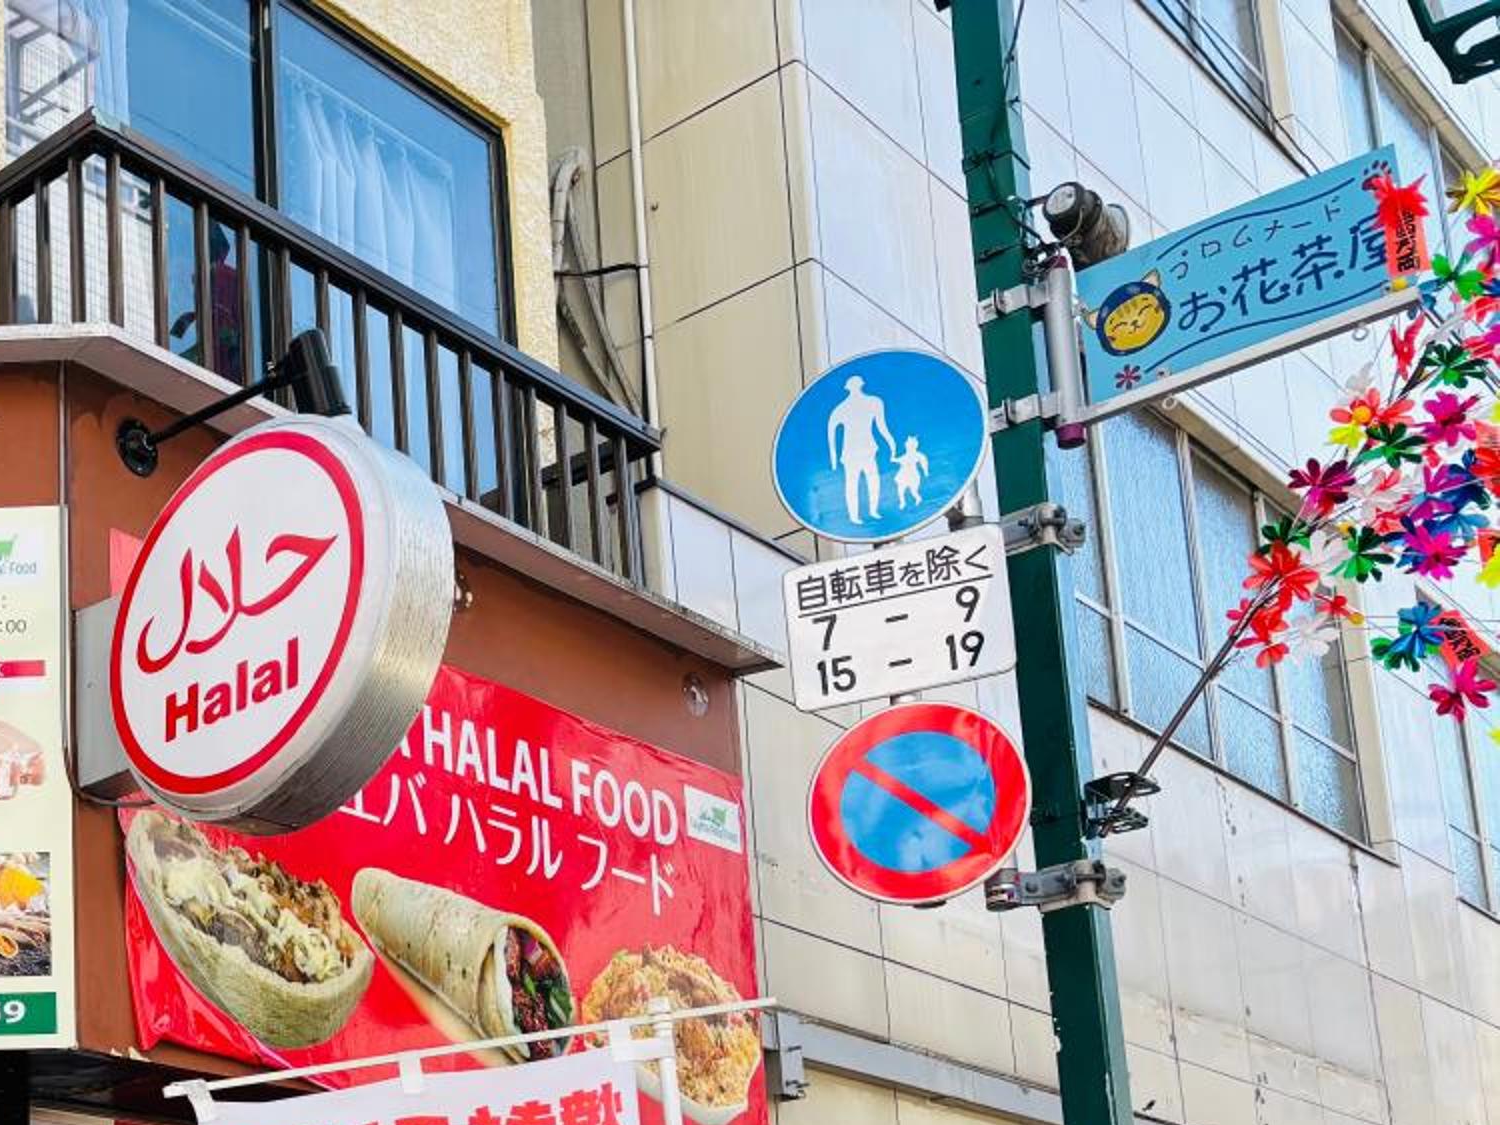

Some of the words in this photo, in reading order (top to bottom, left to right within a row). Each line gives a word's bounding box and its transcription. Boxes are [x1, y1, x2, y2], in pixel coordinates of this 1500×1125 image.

[1178, 212, 1388, 332] お花茶屋
[137, 524, 339, 675] حلال
[798, 542, 990, 612] 自転車を除く
[812, 615, 838, 652] 7
[955, 585, 981, 624] 9
[165, 637, 299, 743] Halal
[816, 655, 858, 697] 15
[944, 630, 986, 673] 19
[423, 704, 563, 806] HALAL
[572, 764, 679, 846] FOOD
[443, 793, 565, 880] ハラル
[577, 830, 676, 917] フード
